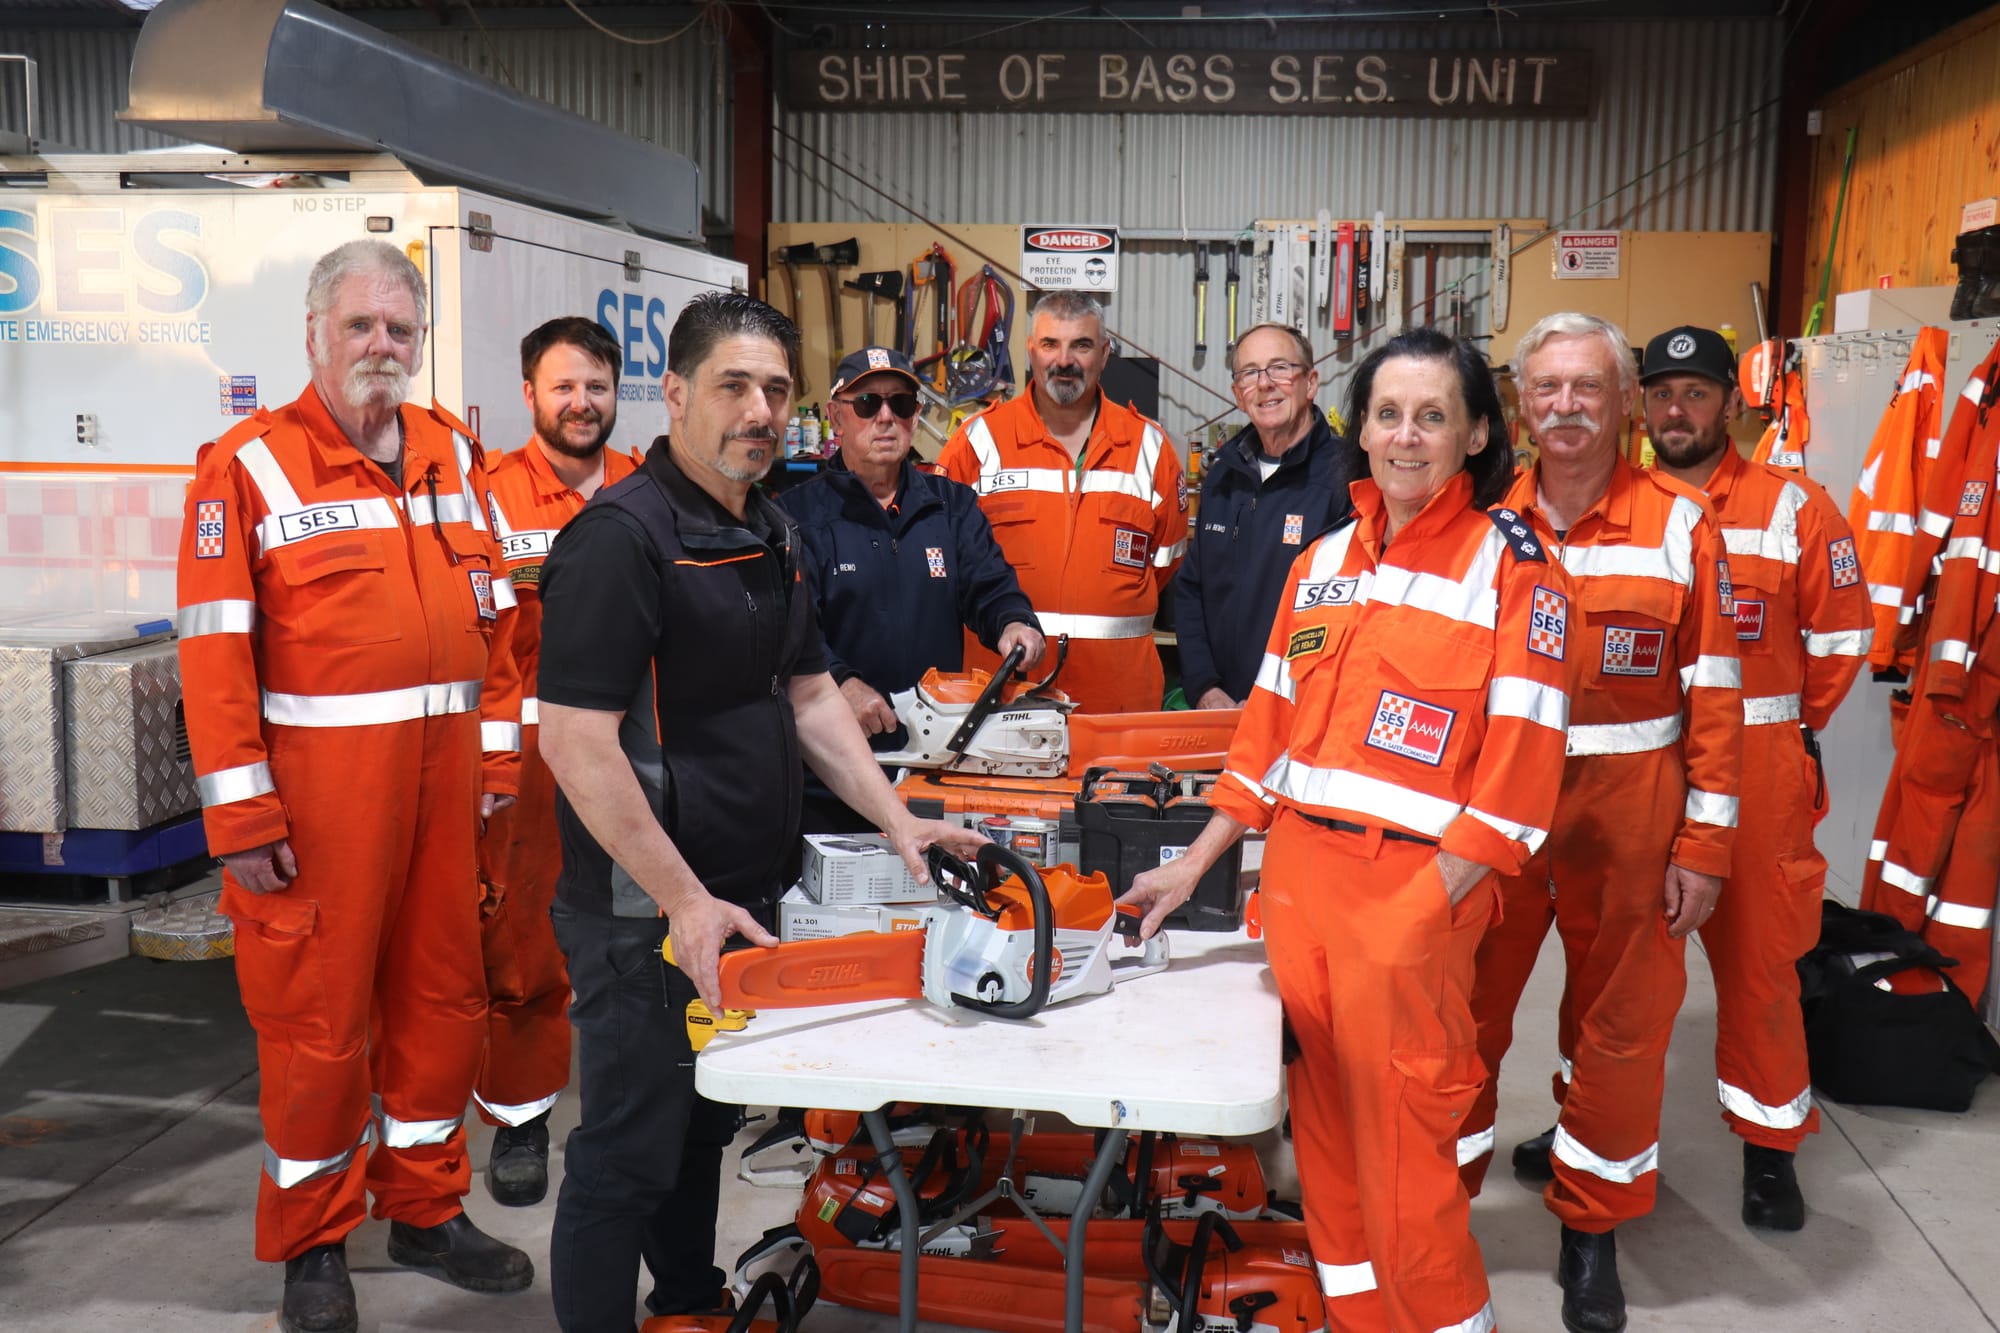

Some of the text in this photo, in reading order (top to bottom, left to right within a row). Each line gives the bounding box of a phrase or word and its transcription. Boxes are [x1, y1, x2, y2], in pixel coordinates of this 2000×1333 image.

[818, 53, 1558, 105] SHIRE OF BASS S.E.S. UNIT
[293, 197, 367, 212] NO STEP
[1039, 234, 1100, 247] DANGER
[1573, 237, 1616, 246] DANGER
[0, 206, 210, 316] SES
[1046, 256, 1061, 265] EYE
[1029, 266, 1077, 275] PROTECTION
[1358, 266, 1368, 289] AEG
[1497, 259, 1505, 282] STIHL
[1034, 276, 1072, 285] REQUIRED
[26, 320, 130, 343] EMERGENCY
[138, 321, 211, 343] SERVICE
[596, 288, 667, 379] SES
[992, 475, 1016, 488] SES
[1962, 494, 1981, 503] SES
[299, 510, 339, 532] SES
[199, 521, 222, 537] SES
[1285, 525, 1301, 534] SES
[1116, 540, 1129, 549] SES
[839, 563, 856, 572] REMO
[927, 559, 945, 567] SES
[1833, 555, 1855, 571] SES
[1304, 583, 1346, 605] SES
[1533, 611, 1564, 636] SES
[1737, 614, 1761, 624] AAMI
[1301, 640, 1317, 650] REMO
[1606, 642, 1659, 656] SES AAMI
[1001, 712, 1032, 722] STIHL
[1378, 710, 1443, 740] SES AAMI
[1160, 734, 1208, 749] STIHL
[1370, 737, 1382, 746] FOR
[1403, 747, 1437, 762] COMMUNITY
[807, 963, 863, 984] STIHL
[689, 1016, 711, 1024] STANLEY
